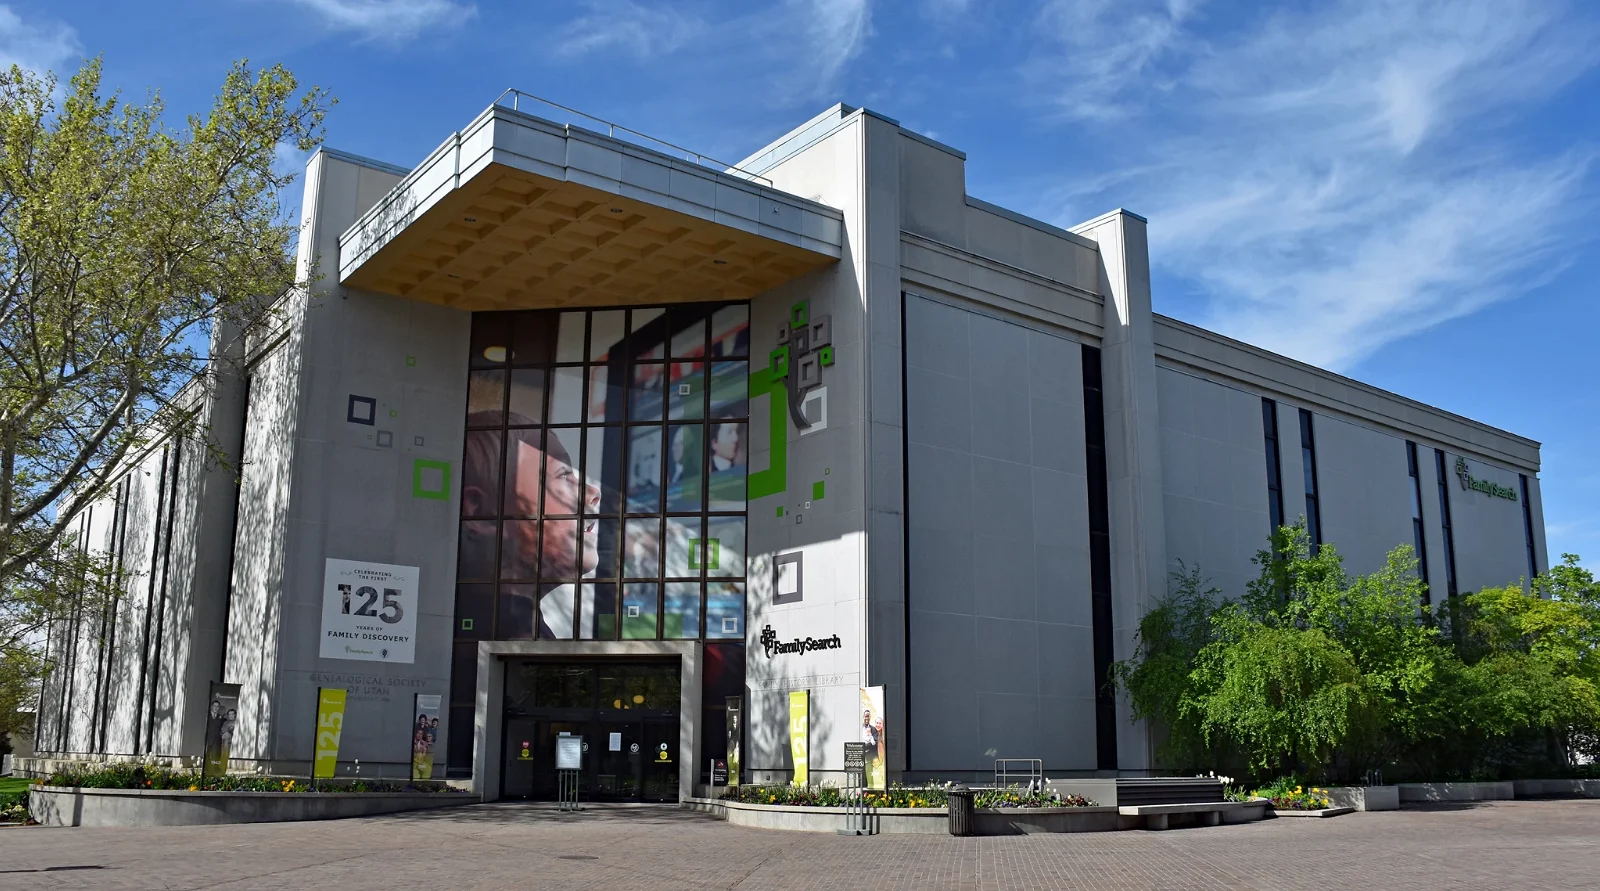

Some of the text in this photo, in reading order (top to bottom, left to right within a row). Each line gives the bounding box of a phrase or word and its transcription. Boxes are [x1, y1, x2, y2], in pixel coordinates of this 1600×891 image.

[1468, 475, 1517, 501] FamilySearch
[354, 569, 392, 577] CELEBRATING
[337, 584, 404, 624] 125
[327, 630, 409, 642] FAMILY DISCOVERY
[773, 634, 841, 656] FamilySearch
[388, 678, 427, 687] SOCIETY
[816, 676, 844, 686] LIBRARY
[364, 686, 390, 695] UTAH
[318, 712, 344, 760] 125
[793, 716, 808, 769] 125
